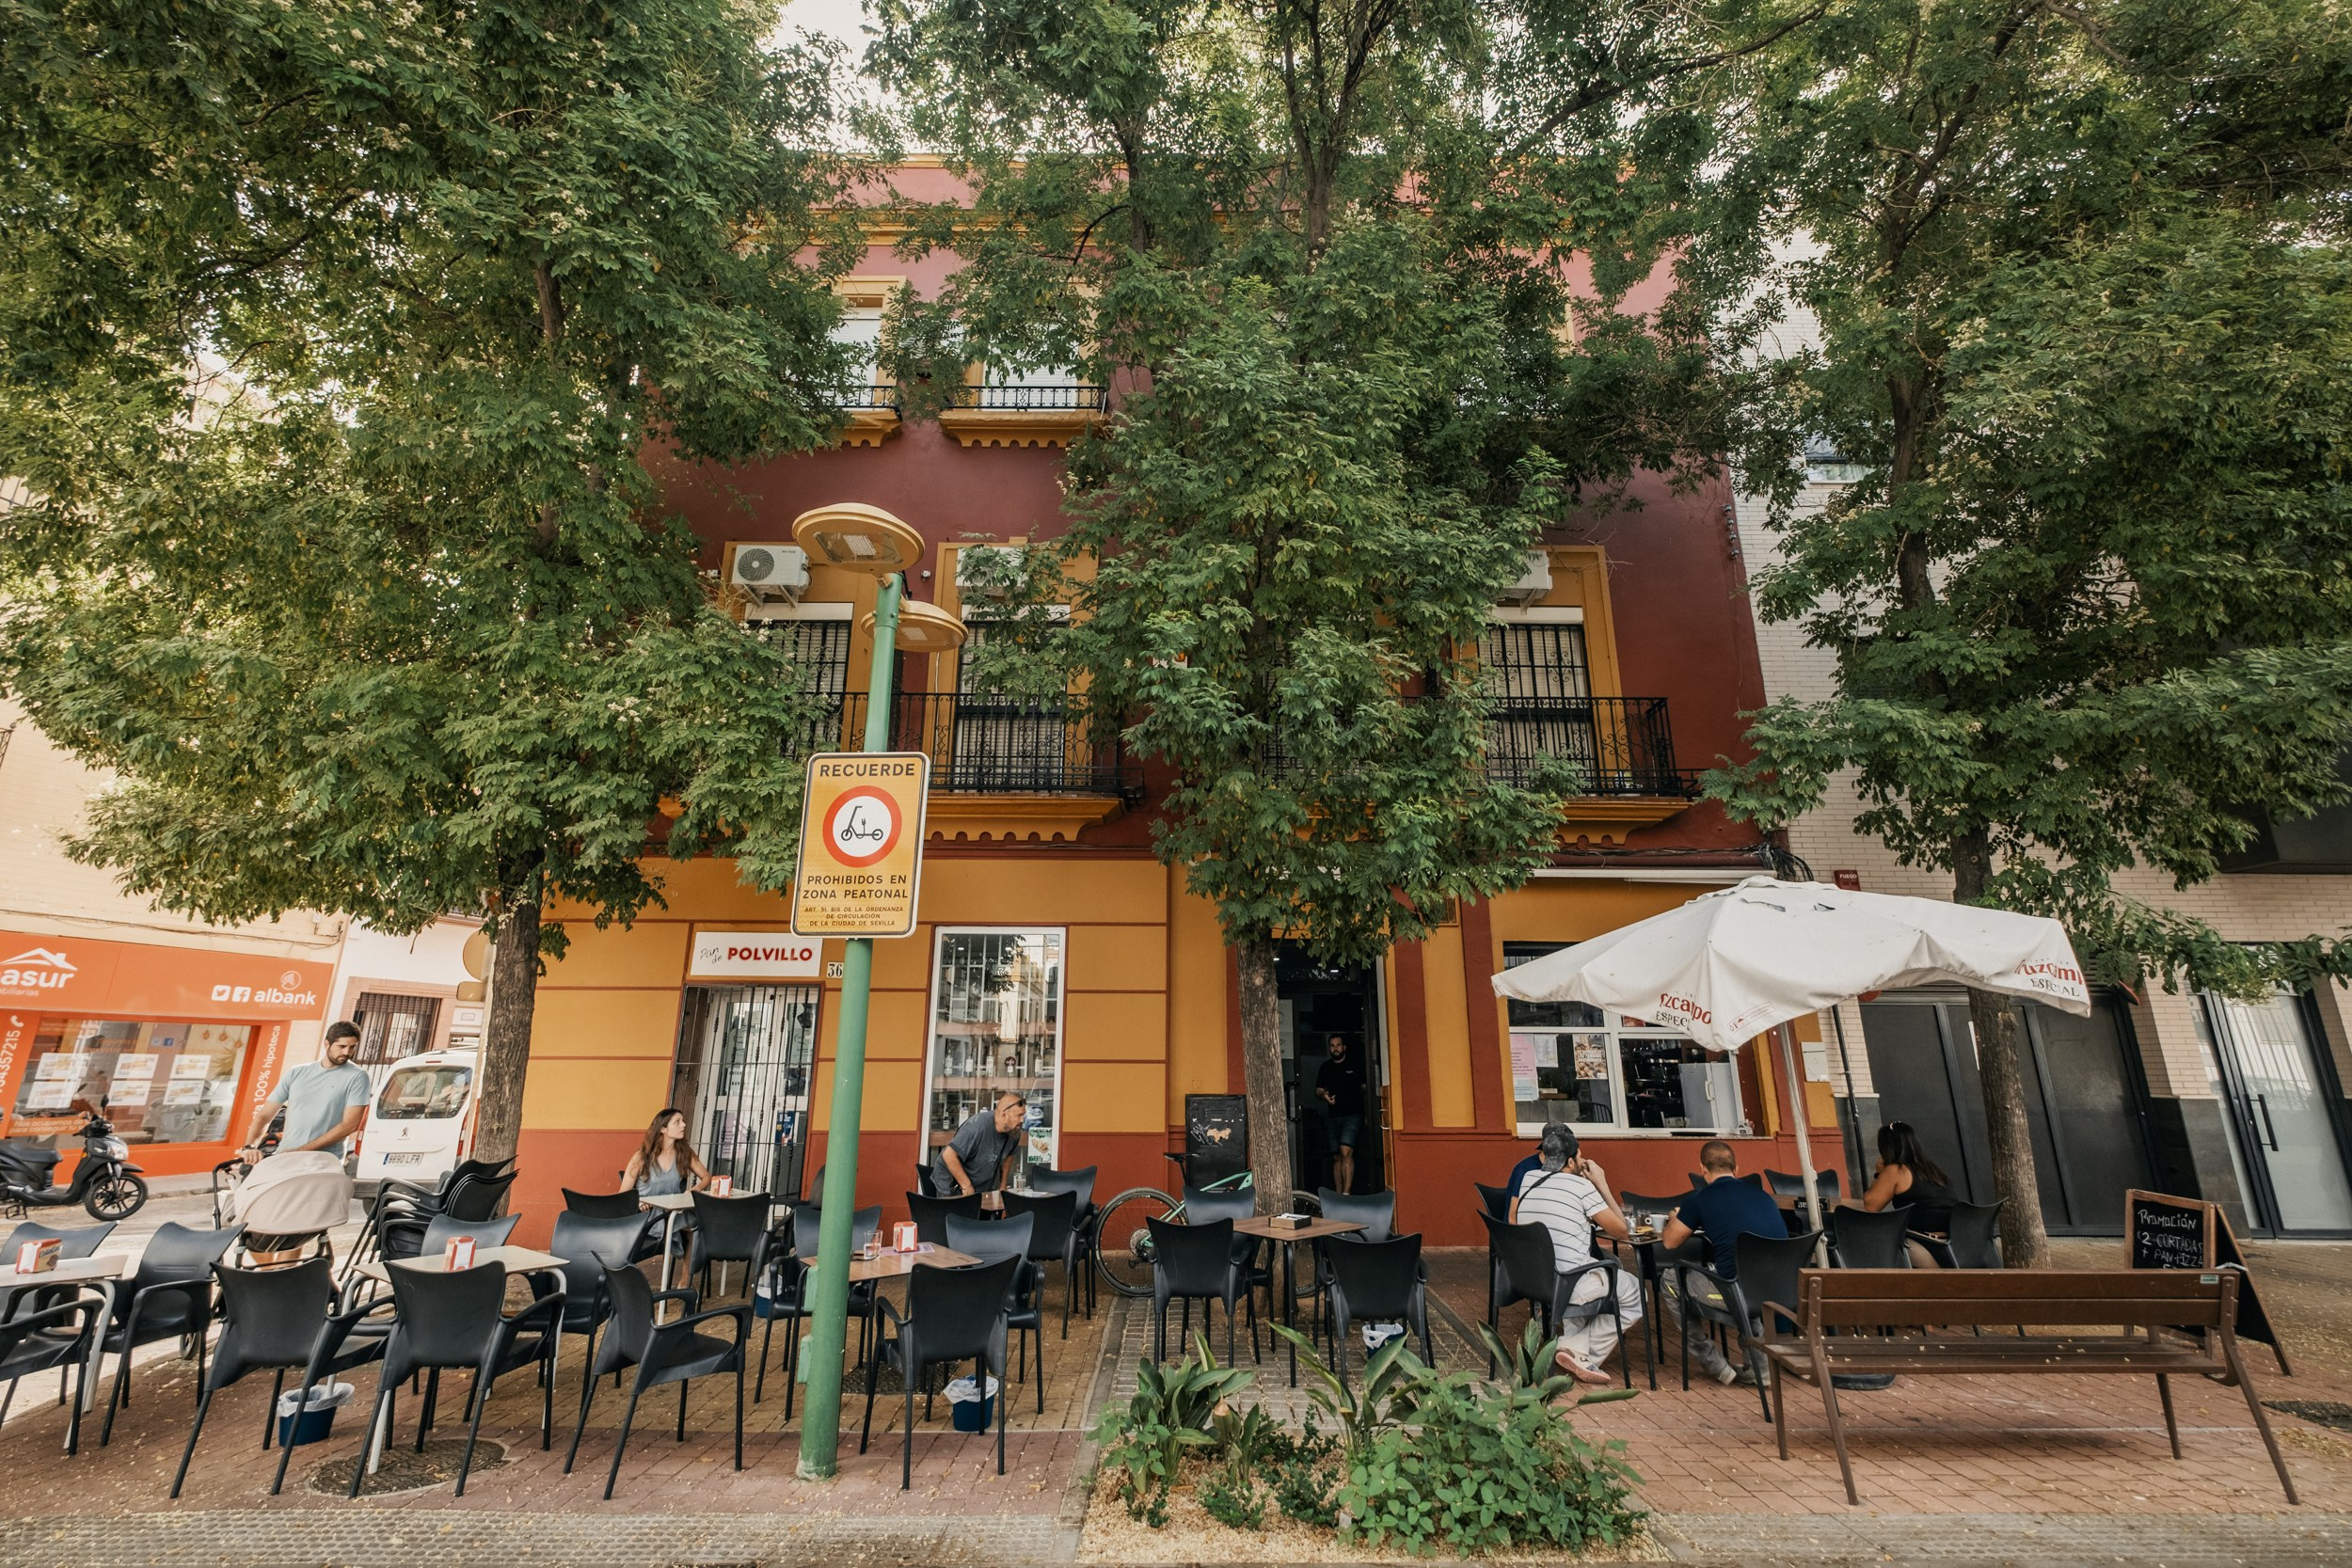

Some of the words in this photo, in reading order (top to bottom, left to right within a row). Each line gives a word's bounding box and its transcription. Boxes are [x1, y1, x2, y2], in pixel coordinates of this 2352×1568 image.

[819, 763, 915, 777] RECUERDE
[807, 875, 883, 885] PROHIBIDOS
[890, 875, 907, 884] EN
[803, 890, 836, 899] ZONA
[844, 889, 909, 899] PEATONAL
[699, 946, 720, 960] Pan
[727, 947, 813, 961] POLVILLO
[711, 954, 723, 964] de
[827, 963, 843, 977] 36
[0, 969, 75, 989] asur
[2030, 978, 2080, 997] ESPCIAL
[253, 988, 317, 1006] albank
[262, 1025, 281, 1069] hipoteca
[254, 1069, 271, 1102] 100%
[2141, 1231, 2153, 1245] 2
